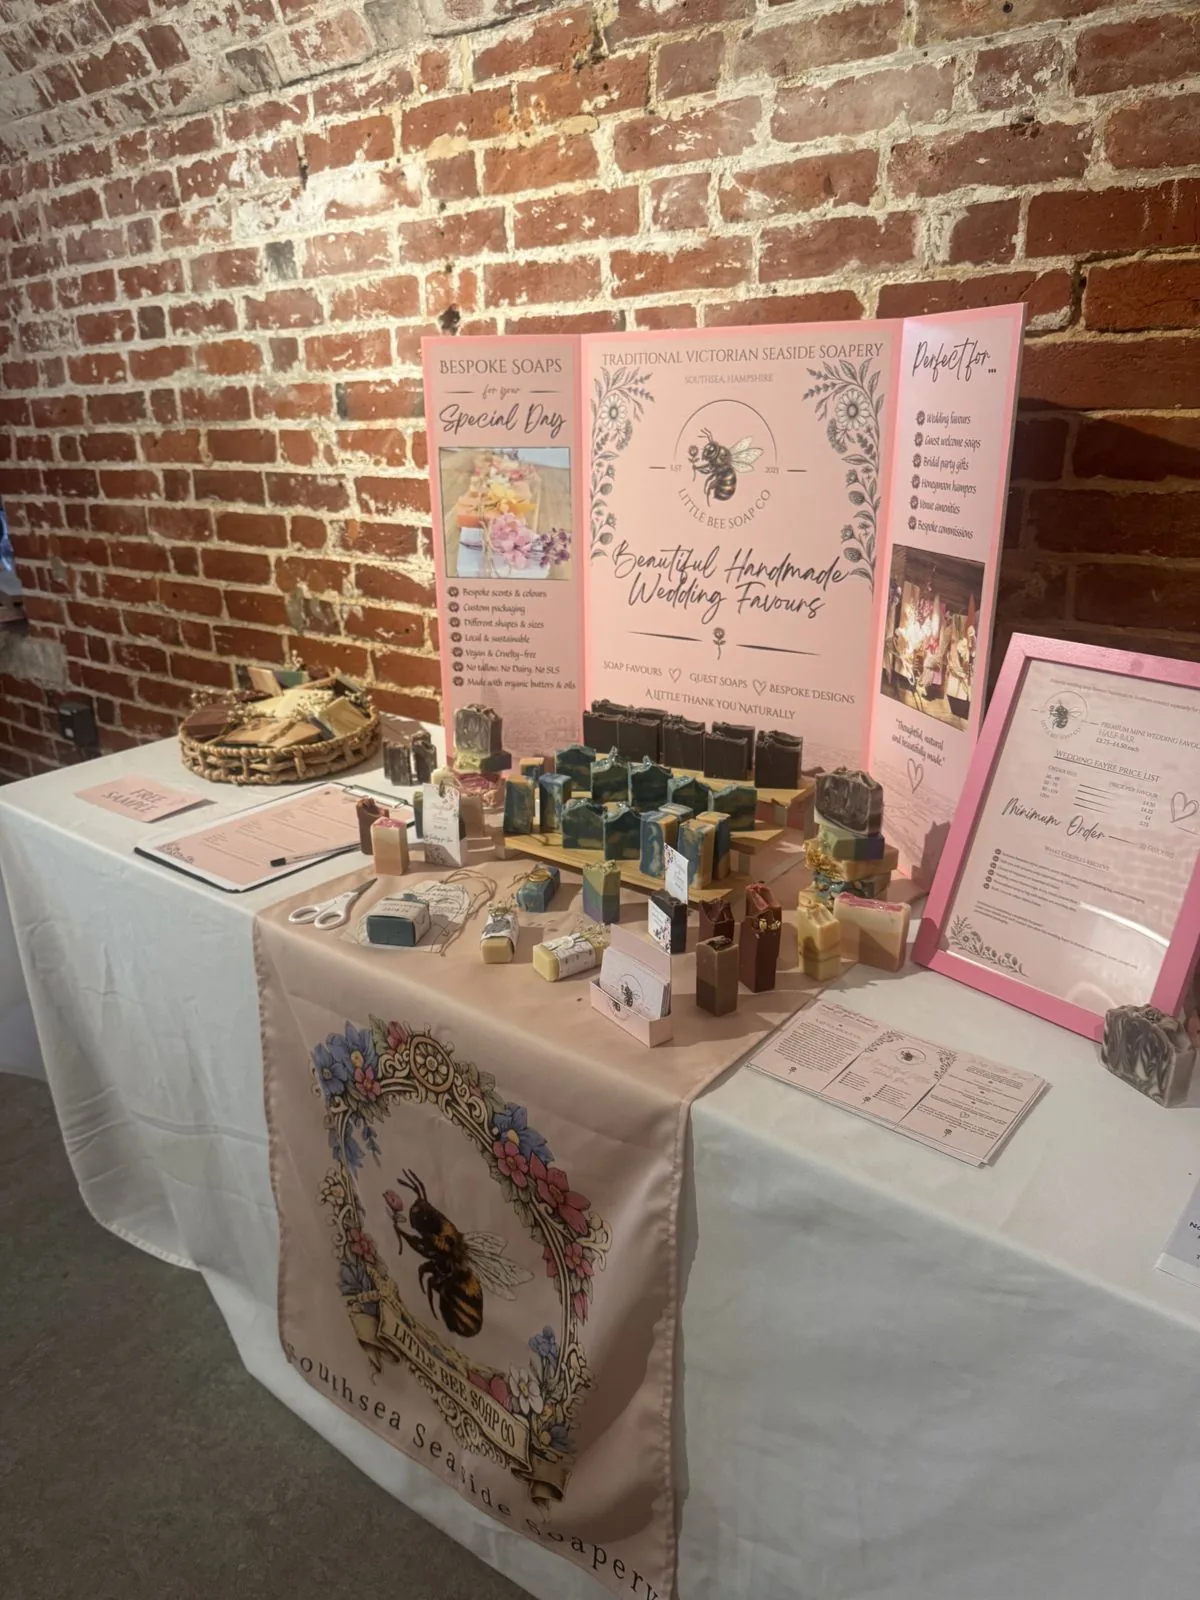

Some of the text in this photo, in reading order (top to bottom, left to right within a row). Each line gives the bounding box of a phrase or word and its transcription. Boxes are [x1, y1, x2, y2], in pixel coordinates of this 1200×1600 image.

[602, 342, 884, 366] TRADITIONAL VICTORIAN SEASIDE SOAPERY
[911, 337, 975, 383] Perfect
[439, 358, 563, 375] BESPOKE SOAPS
[728, 373, 774, 384] HAMPSHIRE
[481, 384, 520, 400] for your
[439, 403, 566, 439] Special Day
[926, 411, 971, 428] Wedding favours
[925, 435, 981, 452] Guest welcome soaps
[923, 456, 969, 474] Bridal party gifts
[921, 478, 977, 498] Honeymoon hampers
[678, 488, 772, 529] LITTLE BEE SOAP CO
[918, 520, 974, 540] Bespoke commissions
[612, 540, 849, 591] Beautiful Handmade
[462, 588, 548, 599] Bespoke scents & colours
[628, 571, 826, 625] Wedding Favours
[463, 603, 526, 616] Custom packaging
[464, 617, 545, 630] Different shapes & sizes
[465, 633, 530, 643] Local & sustainable
[465, 649, 536, 661] Vegan & Cruelty-free
[535, 666, 545, 674] No
[546, 666, 560, 674] SLS
[467, 678, 486, 686] Made
[487, 678, 502, 687] with
[505, 680, 528, 691] organic
[530, 679, 554, 689] butters
[564, 681, 577, 689] oils
[603, 660, 855, 704] SOAP FAVOURS GUEST SOAPS BESPOKE DESIGNS
[646, 689, 796, 720] A LITTLE THANK YOU NATURALLY
[1101, 721, 1129, 733] PREMIUM
[1130, 728, 1146, 737] MINI
[1147, 731, 1178, 745] WEDDING
[1056, 749, 1160, 783] WEDDING FAYRE PRICE LIST
[1001, 797, 1062, 827] Minimum
[1066, 815, 1106, 842] Order
[440, 1366, 467, 1401] BEE
[470, 1389, 500, 1432] SOAP
[500, 1418, 516, 1448] CO
